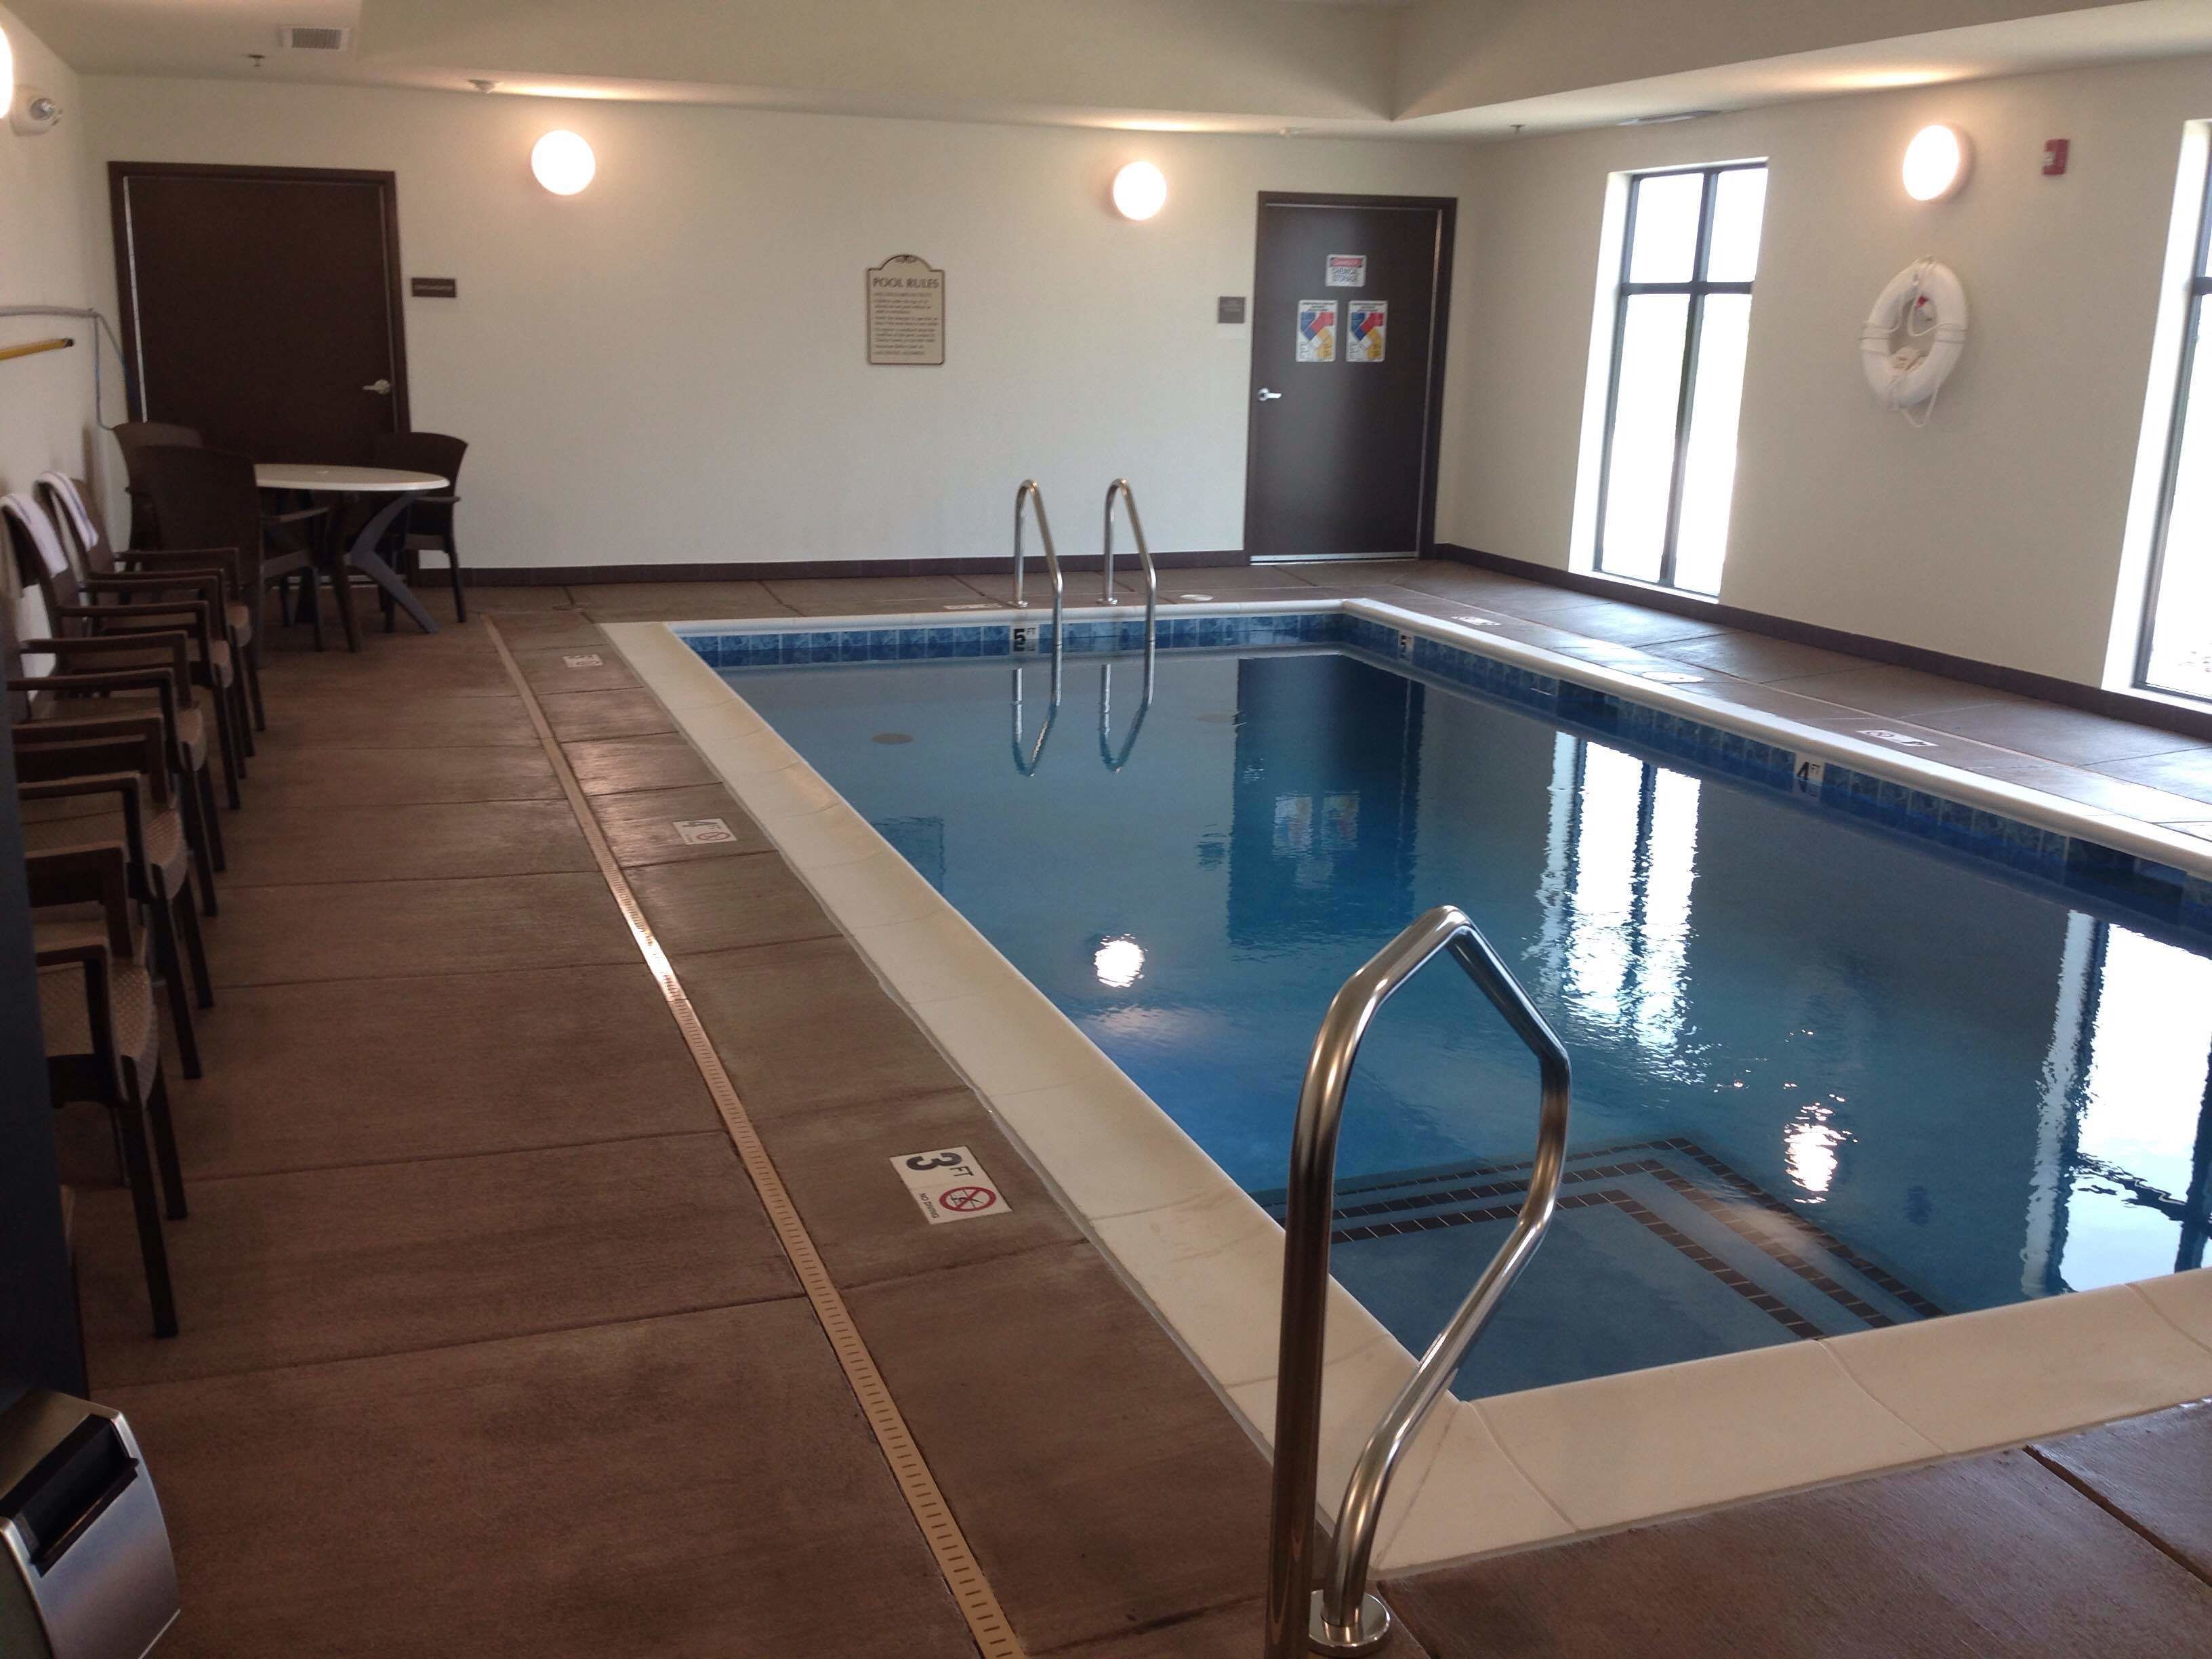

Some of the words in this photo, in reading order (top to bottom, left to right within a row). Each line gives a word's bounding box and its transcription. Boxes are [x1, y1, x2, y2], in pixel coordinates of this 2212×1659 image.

[873, 277, 904, 288] POOL
[906, 278, 940, 289] RULES
[1013, 628, 1026, 641] 5
[1797, 761, 1810, 780] 4
[905, 1152, 962, 1171] 3
[949, 1165, 974, 1177] FT
[918, 1192, 928, 1202] NO
